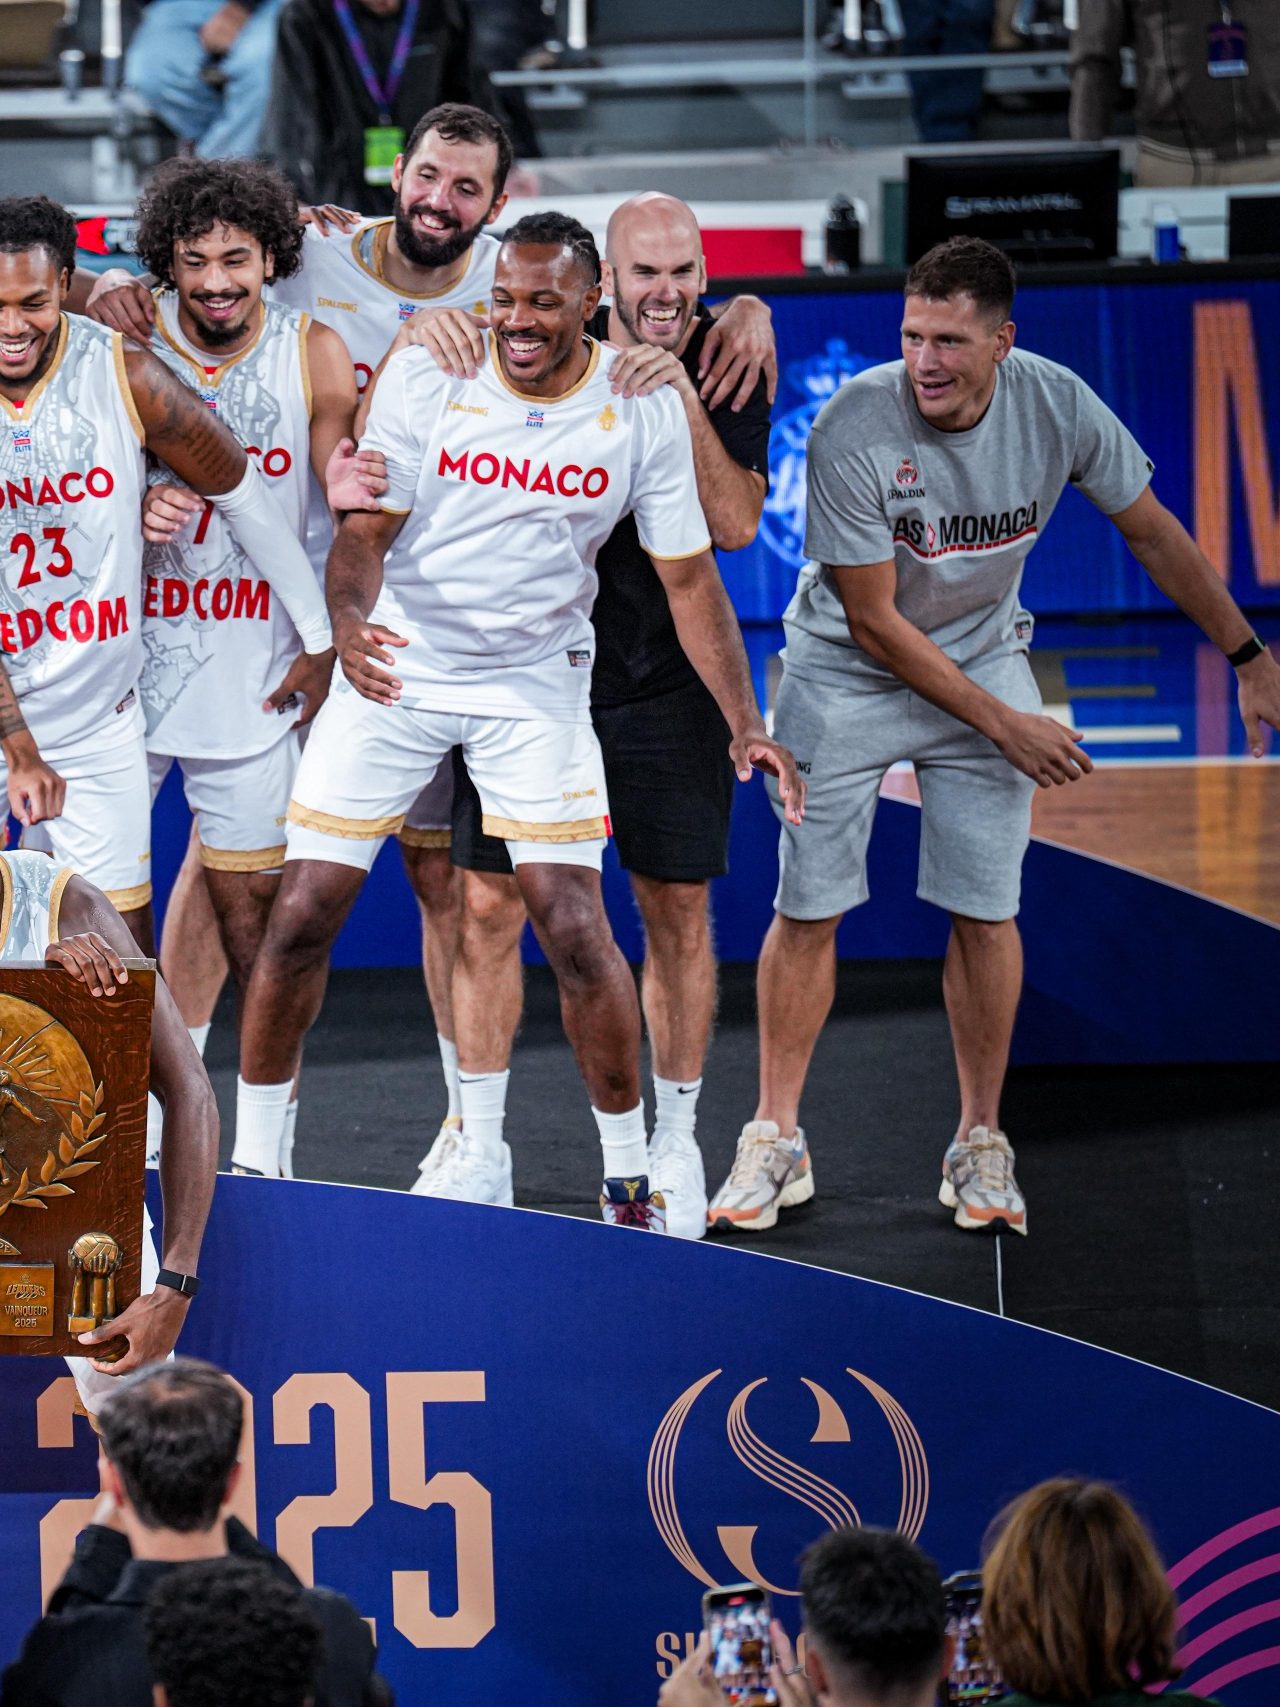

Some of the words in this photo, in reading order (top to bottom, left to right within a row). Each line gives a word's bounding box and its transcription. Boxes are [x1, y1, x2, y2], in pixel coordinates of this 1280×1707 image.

[437, 447, 610, 499] MONACO
[887, 487, 927, 502] SPALDIN
[894, 519, 925, 545] AS
[939, 500, 1038, 548] MONACO
[9, 527, 74, 589] 23
[143, 576, 271, 621] EDCOM
[4, 1305, 48, 1317] VAINQUEUR
[14, 1318, 37, 1328] 2025
[36, 1370, 497, 1655] 25
